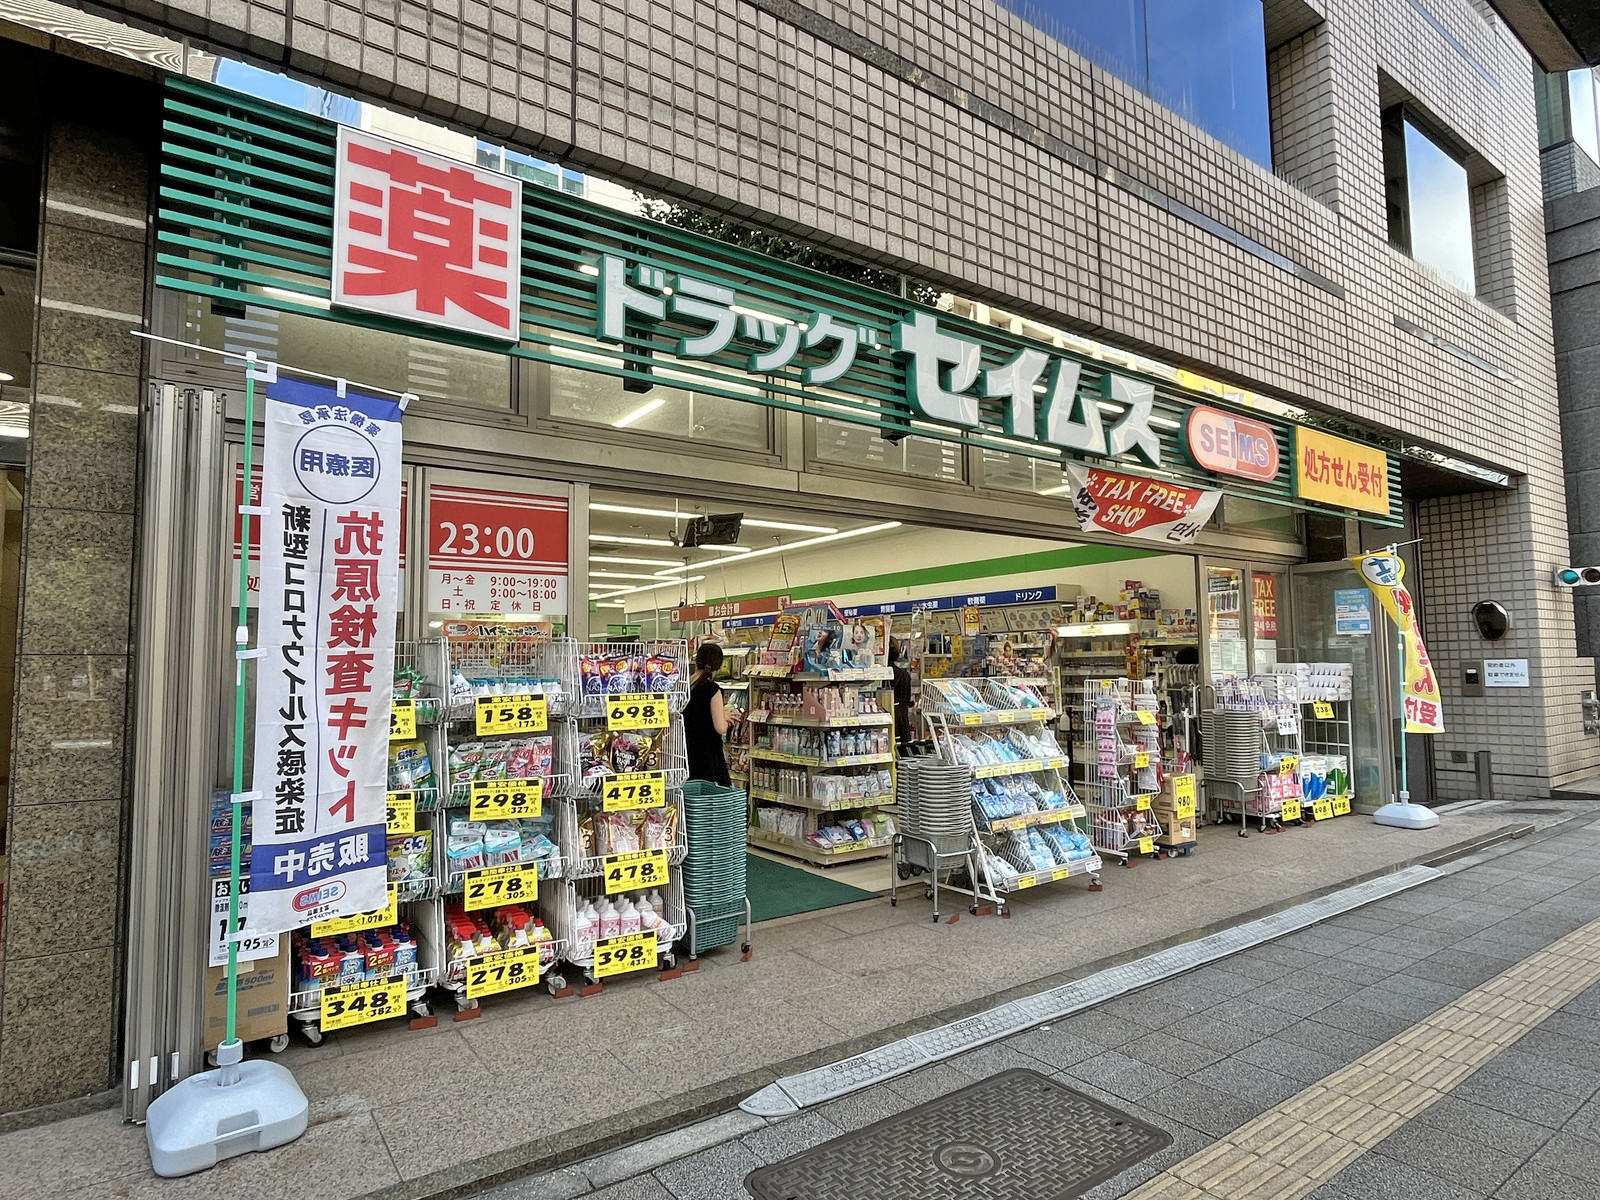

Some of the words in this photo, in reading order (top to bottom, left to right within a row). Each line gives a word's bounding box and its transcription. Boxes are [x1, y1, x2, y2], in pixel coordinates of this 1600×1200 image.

[343, 141, 512, 330] 薬
[599, 253, 877, 386] ドラッグ
[900, 312, 1161, 467] セイムス
[1200, 423, 1270, 468] SEIMS
[1304, 446, 1382, 498] 処方せん受付
[1097, 477, 1142, 501] TAX
[1139, 483, 1187, 515] FREE
[1101, 504, 1147, 528] SHOP
[439, 521, 534, 559] 23:00
[453, 586, 464, 597] 土
[1015, 591, 1042, 602] ドリンク
[1254, 578, 1273, 598] TAX
[441, 598, 475, 611] 日・祝
[714, 603, 734, 616] お会計
[1253, 599, 1276, 617] FREE
[485, 707, 533, 723] 158
[611, 705, 656, 719] 698
[1278, 721, 1292, 730] 298
[474, 792, 527, 809] 298
[607, 784, 652, 800] 478
[510, 806, 529, 814] 327
[1283, 806, 1297, 815] 598
[608, 862, 654, 881] 478
[469, 878, 522, 899] 278
[506, 890, 525, 900] 305
[598, 946, 644, 966] 398
[629, 958, 647, 967] 437
[470, 962, 524, 986] 278
[508, 975, 527, 986] 305
[326, 992, 389, 1018] 348
[370, 1005, 393, 1018] 382
